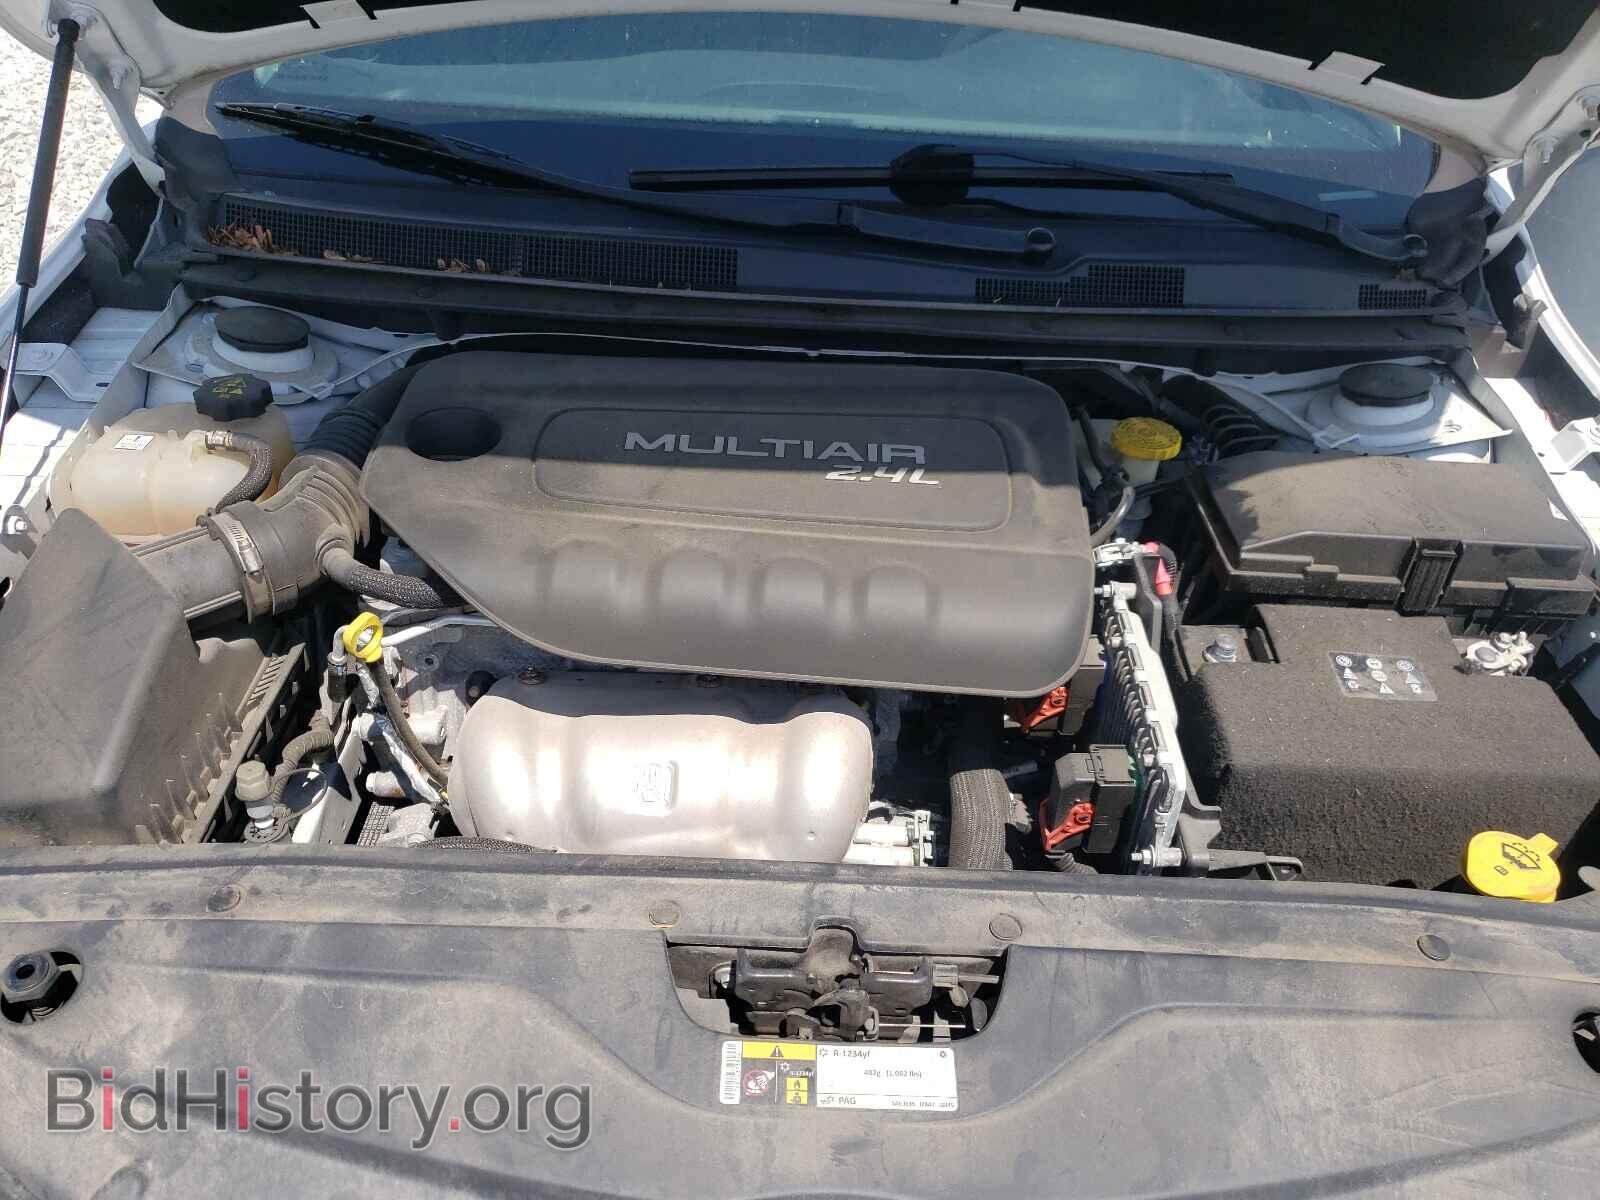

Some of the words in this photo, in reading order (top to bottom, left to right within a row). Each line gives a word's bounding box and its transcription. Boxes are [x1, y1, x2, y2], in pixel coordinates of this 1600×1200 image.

[624, 431, 926, 465] MULTIAIR
[825, 465, 940, 486] 2.4L
[833, 1049, 870, 1059] R-1234yf
[838, 1096, 856, 1105] PAG
